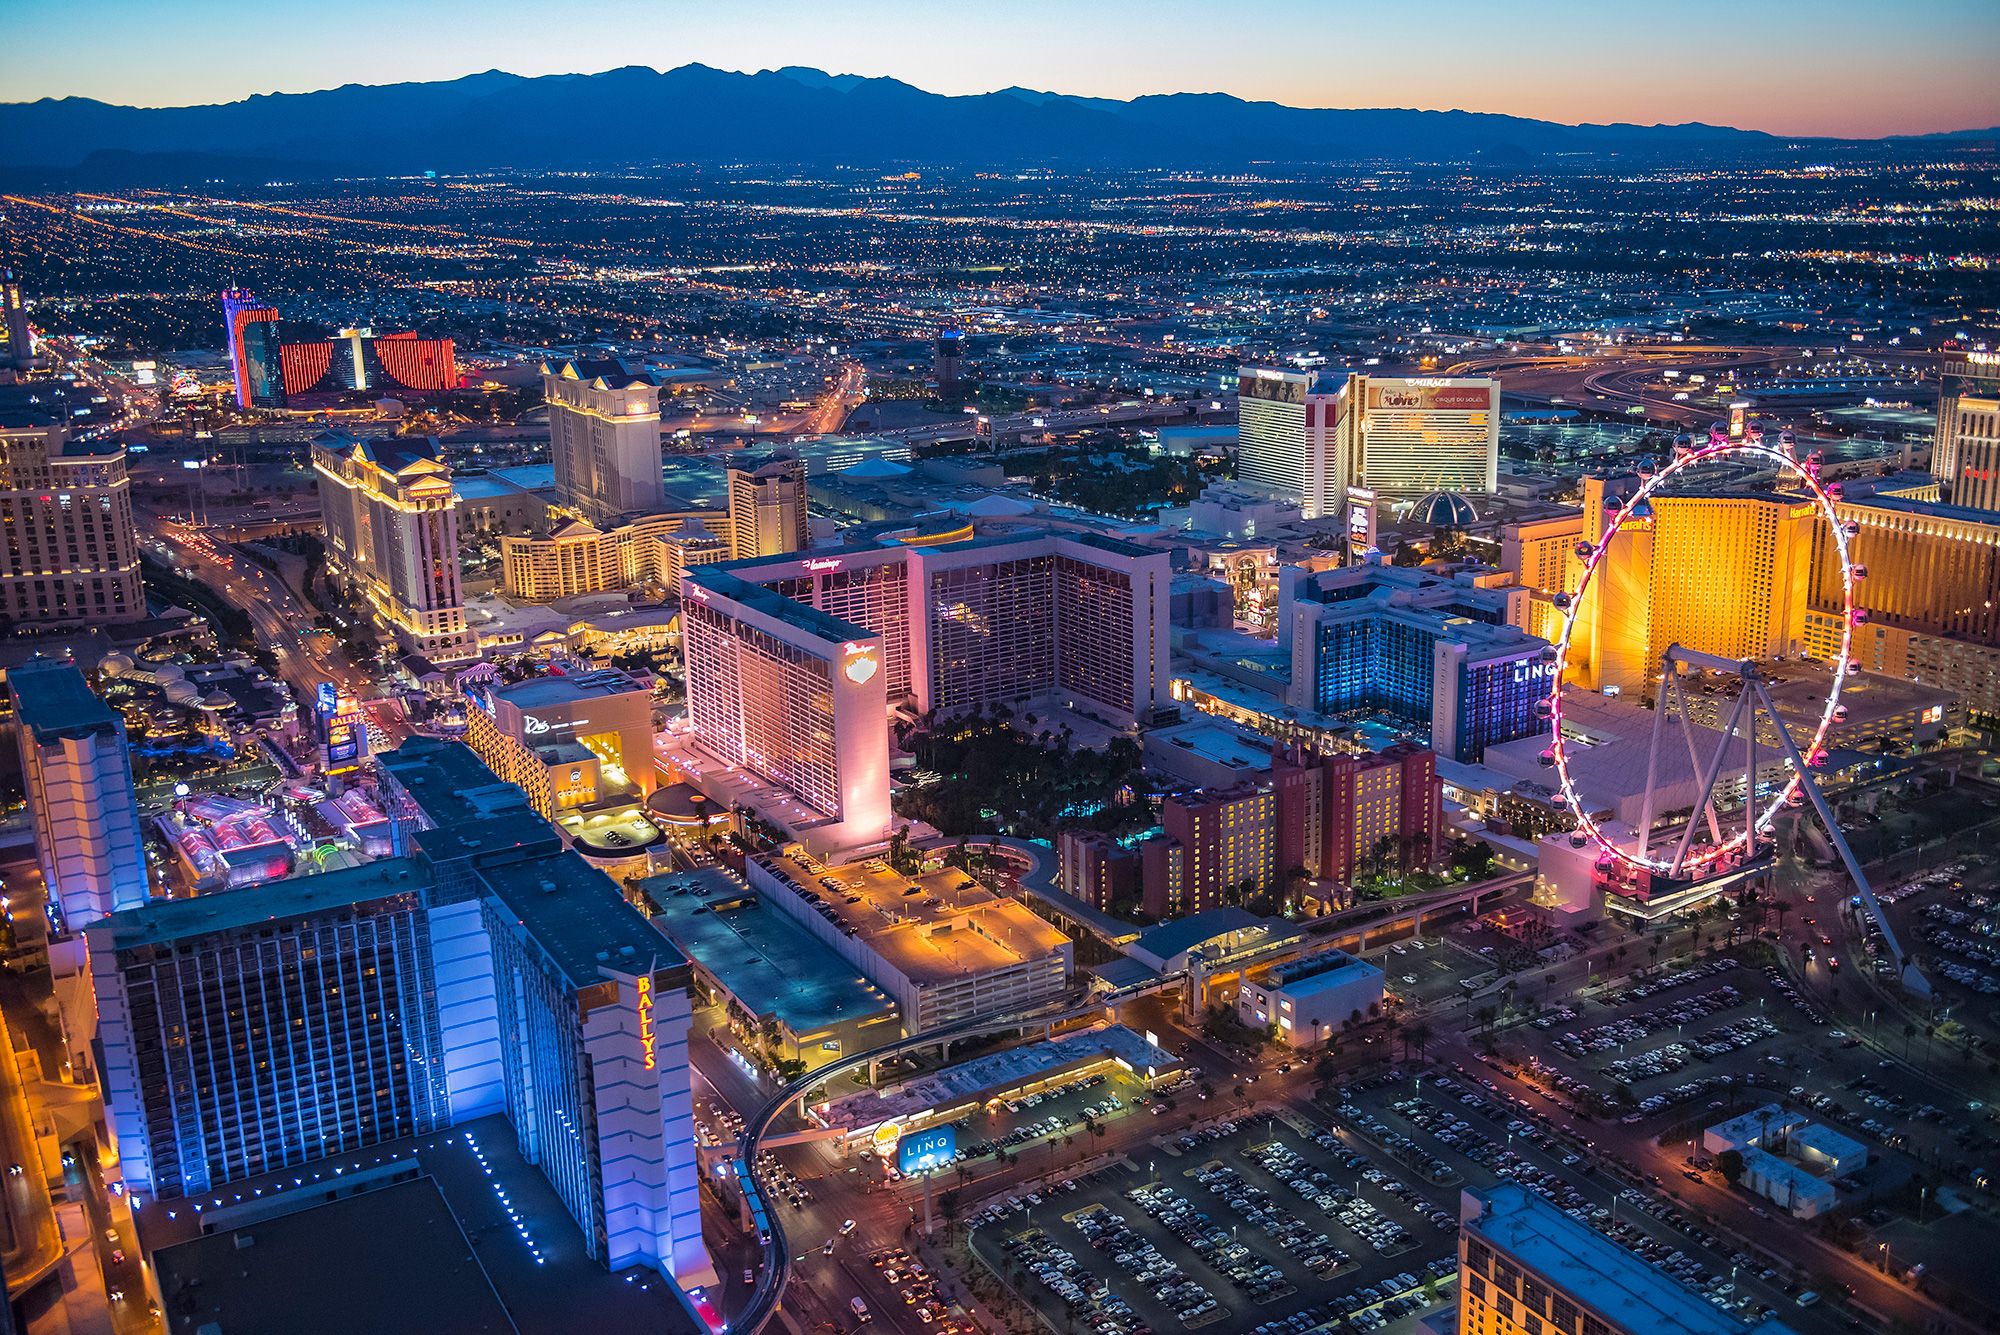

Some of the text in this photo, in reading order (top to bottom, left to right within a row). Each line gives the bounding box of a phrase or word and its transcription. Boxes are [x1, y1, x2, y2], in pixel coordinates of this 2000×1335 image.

[1415, 379, 1452, 387] MIRAGE
[1389, 397, 1413, 406] LOVE
[410, 487, 450, 497] CAESARS PALACE
[801, 558, 843, 571] Flamingo
[907, 1137, 948, 1157] LINQ
